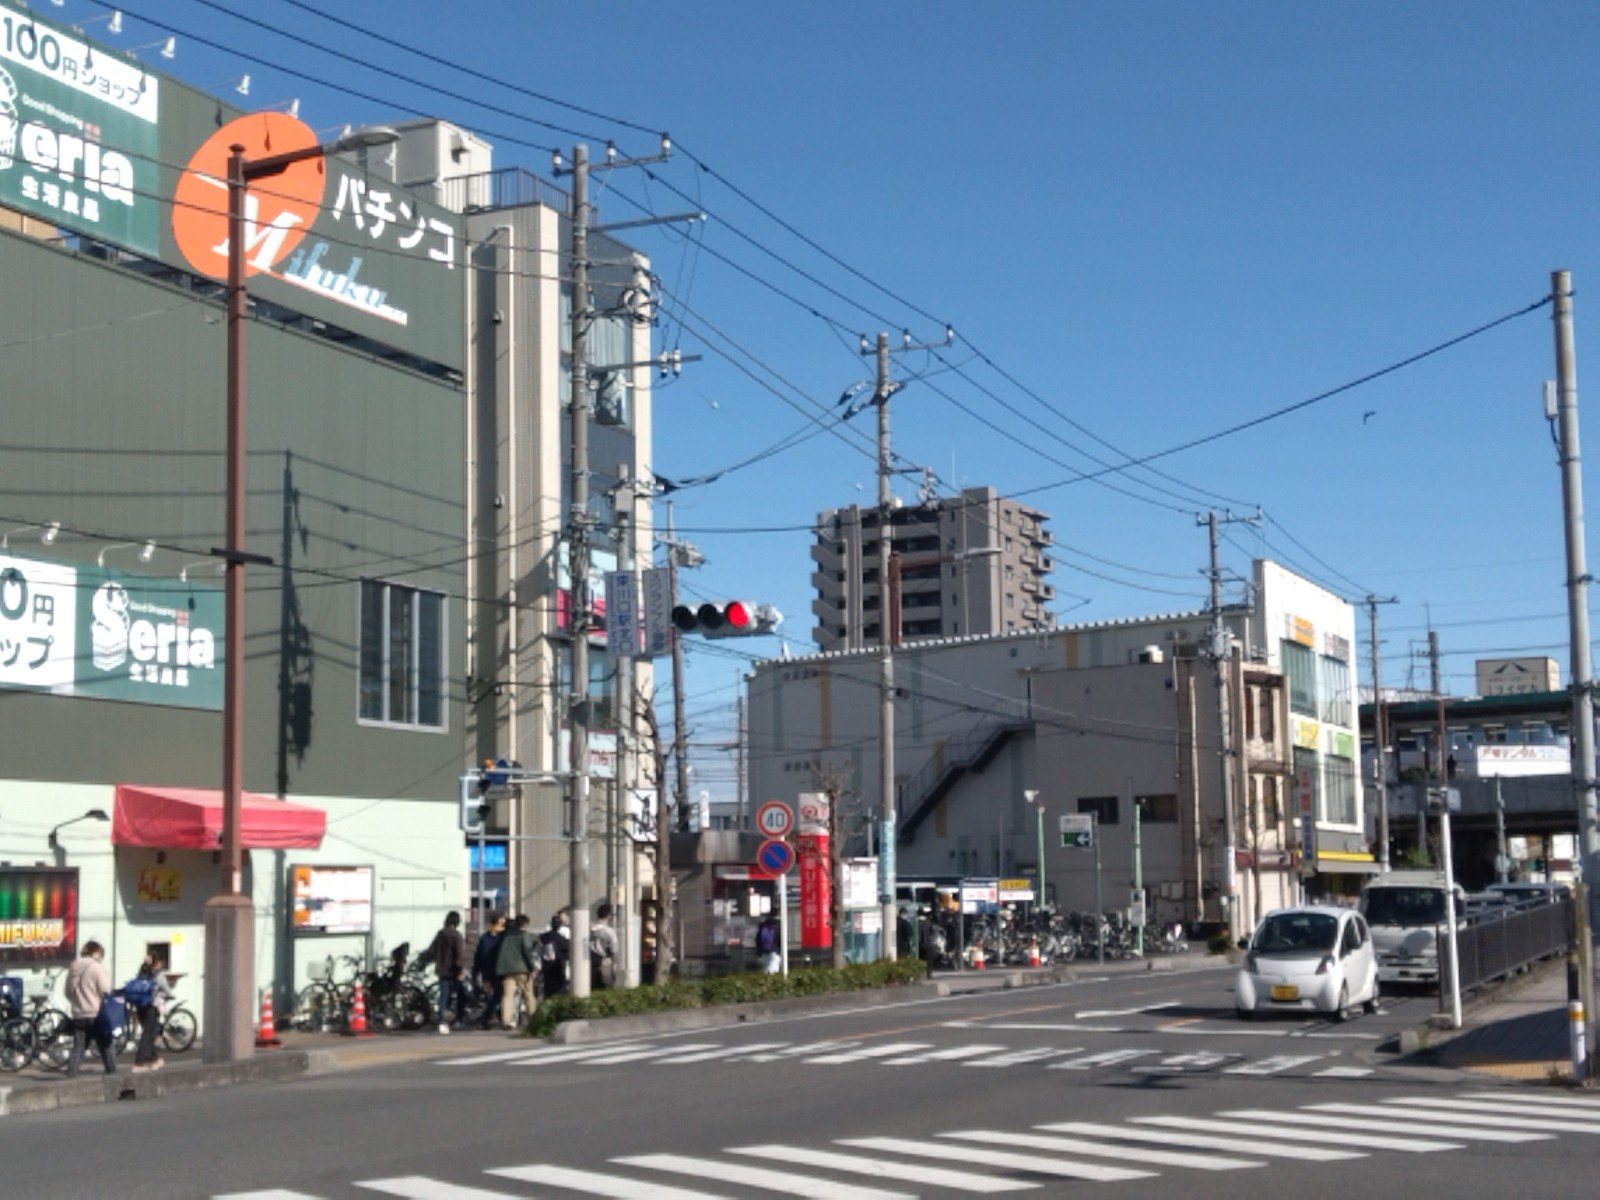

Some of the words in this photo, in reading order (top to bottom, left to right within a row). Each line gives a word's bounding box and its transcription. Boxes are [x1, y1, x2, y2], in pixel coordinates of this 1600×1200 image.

[3, 15, 143, 106] 100円ショップ
[333, 173, 454, 270] パチンコ
[0, 566, 54, 627] 0円
[92, 581, 215, 673] Seria
[767, 812, 784, 828] 40
[0, 921, 63, 946] IFUKU
